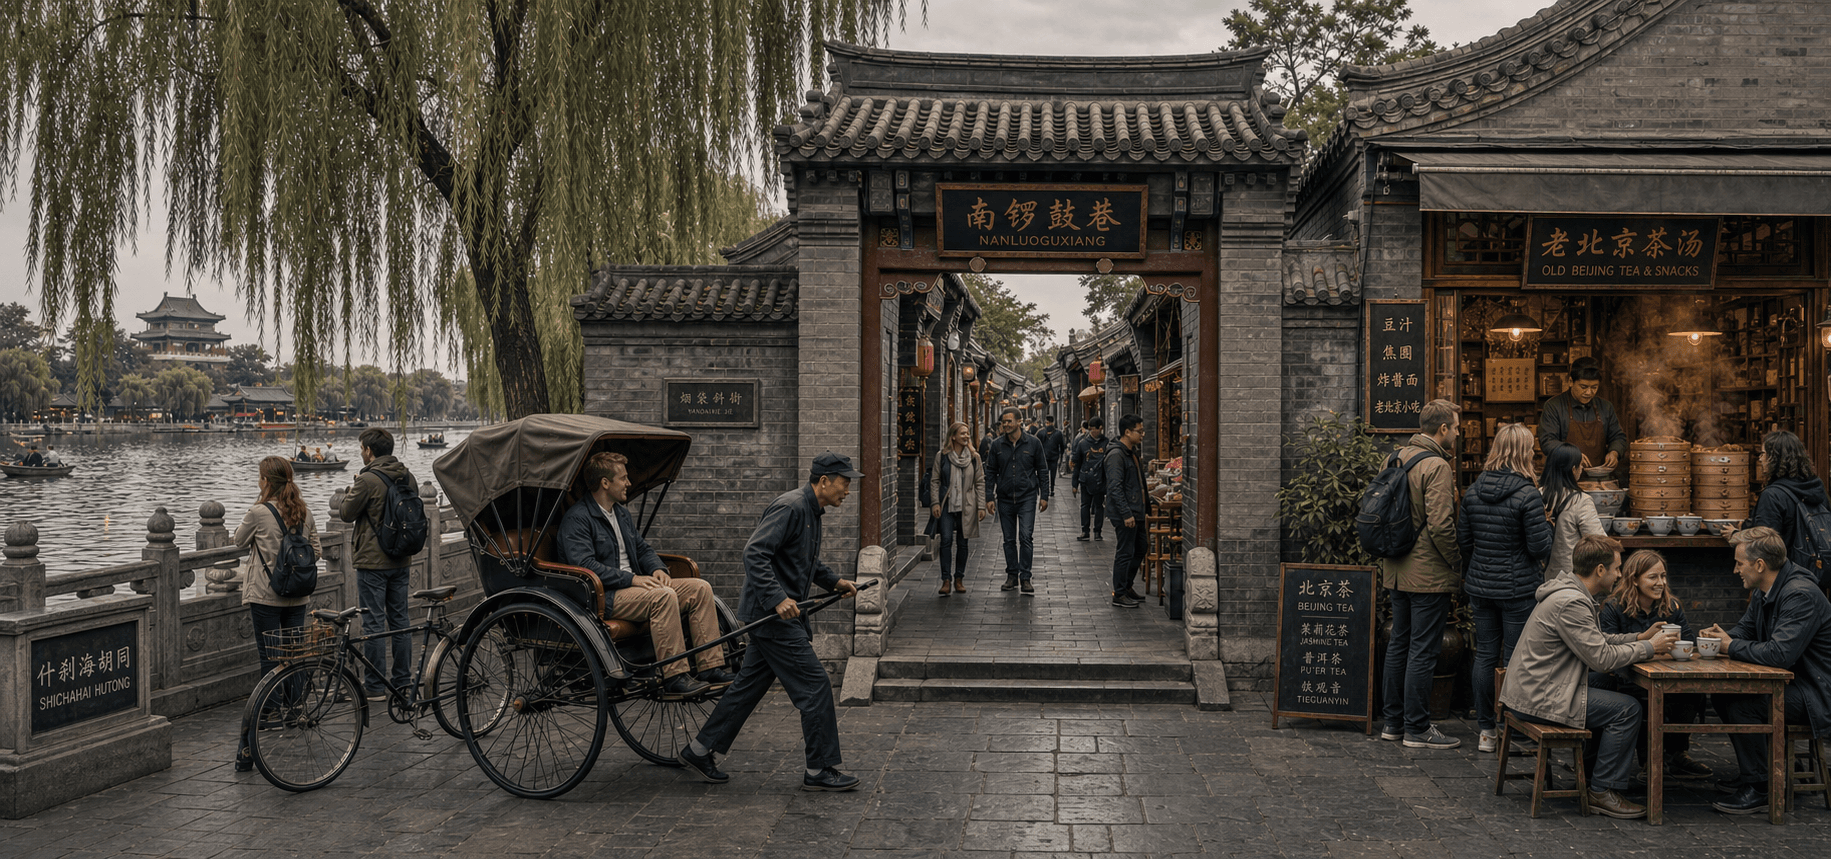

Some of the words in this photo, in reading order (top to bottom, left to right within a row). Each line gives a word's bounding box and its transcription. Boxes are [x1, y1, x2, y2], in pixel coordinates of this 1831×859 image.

[966, 196, 1122, 232] 南锣鼓巷
[979, 235, 1106, 247] NANLUOGUXIANG
[1541, 226, 1704, 259] 老北京茶汤
[1541, 264, 1566, 276] OLD
[1571, 265, 1614, 277] BEIJING
[1619, 265, 1641, 277] TEA
[1643, 265, 1652, 277] &
[1654, 265, 1699, 277] SNACKS
[1382, 316, 1413, 333] 豆汁
[1374, 399, 1421, 414] 老北京小吃
[1298, 579, 1354, 599] 北京茶
[1297, 601, 1333, 612] BEIJING
[1336, 603, 1355, 613] TEA
[1299, 637, 1332, 646] JASMINE
[1333, 638, 1349, 647] TEA
[1302, 651, 1342, 666] 普洱茶
[36, 645, 131, 688] 什刹海胡同
[1330, 667, 1347, 676] TEA
[39, 685, 92, 711] SHICHAHAI
[94, 676, 131, 698] HUTONG
[1296, 695, 1349, 706] TIEGUANYIN
